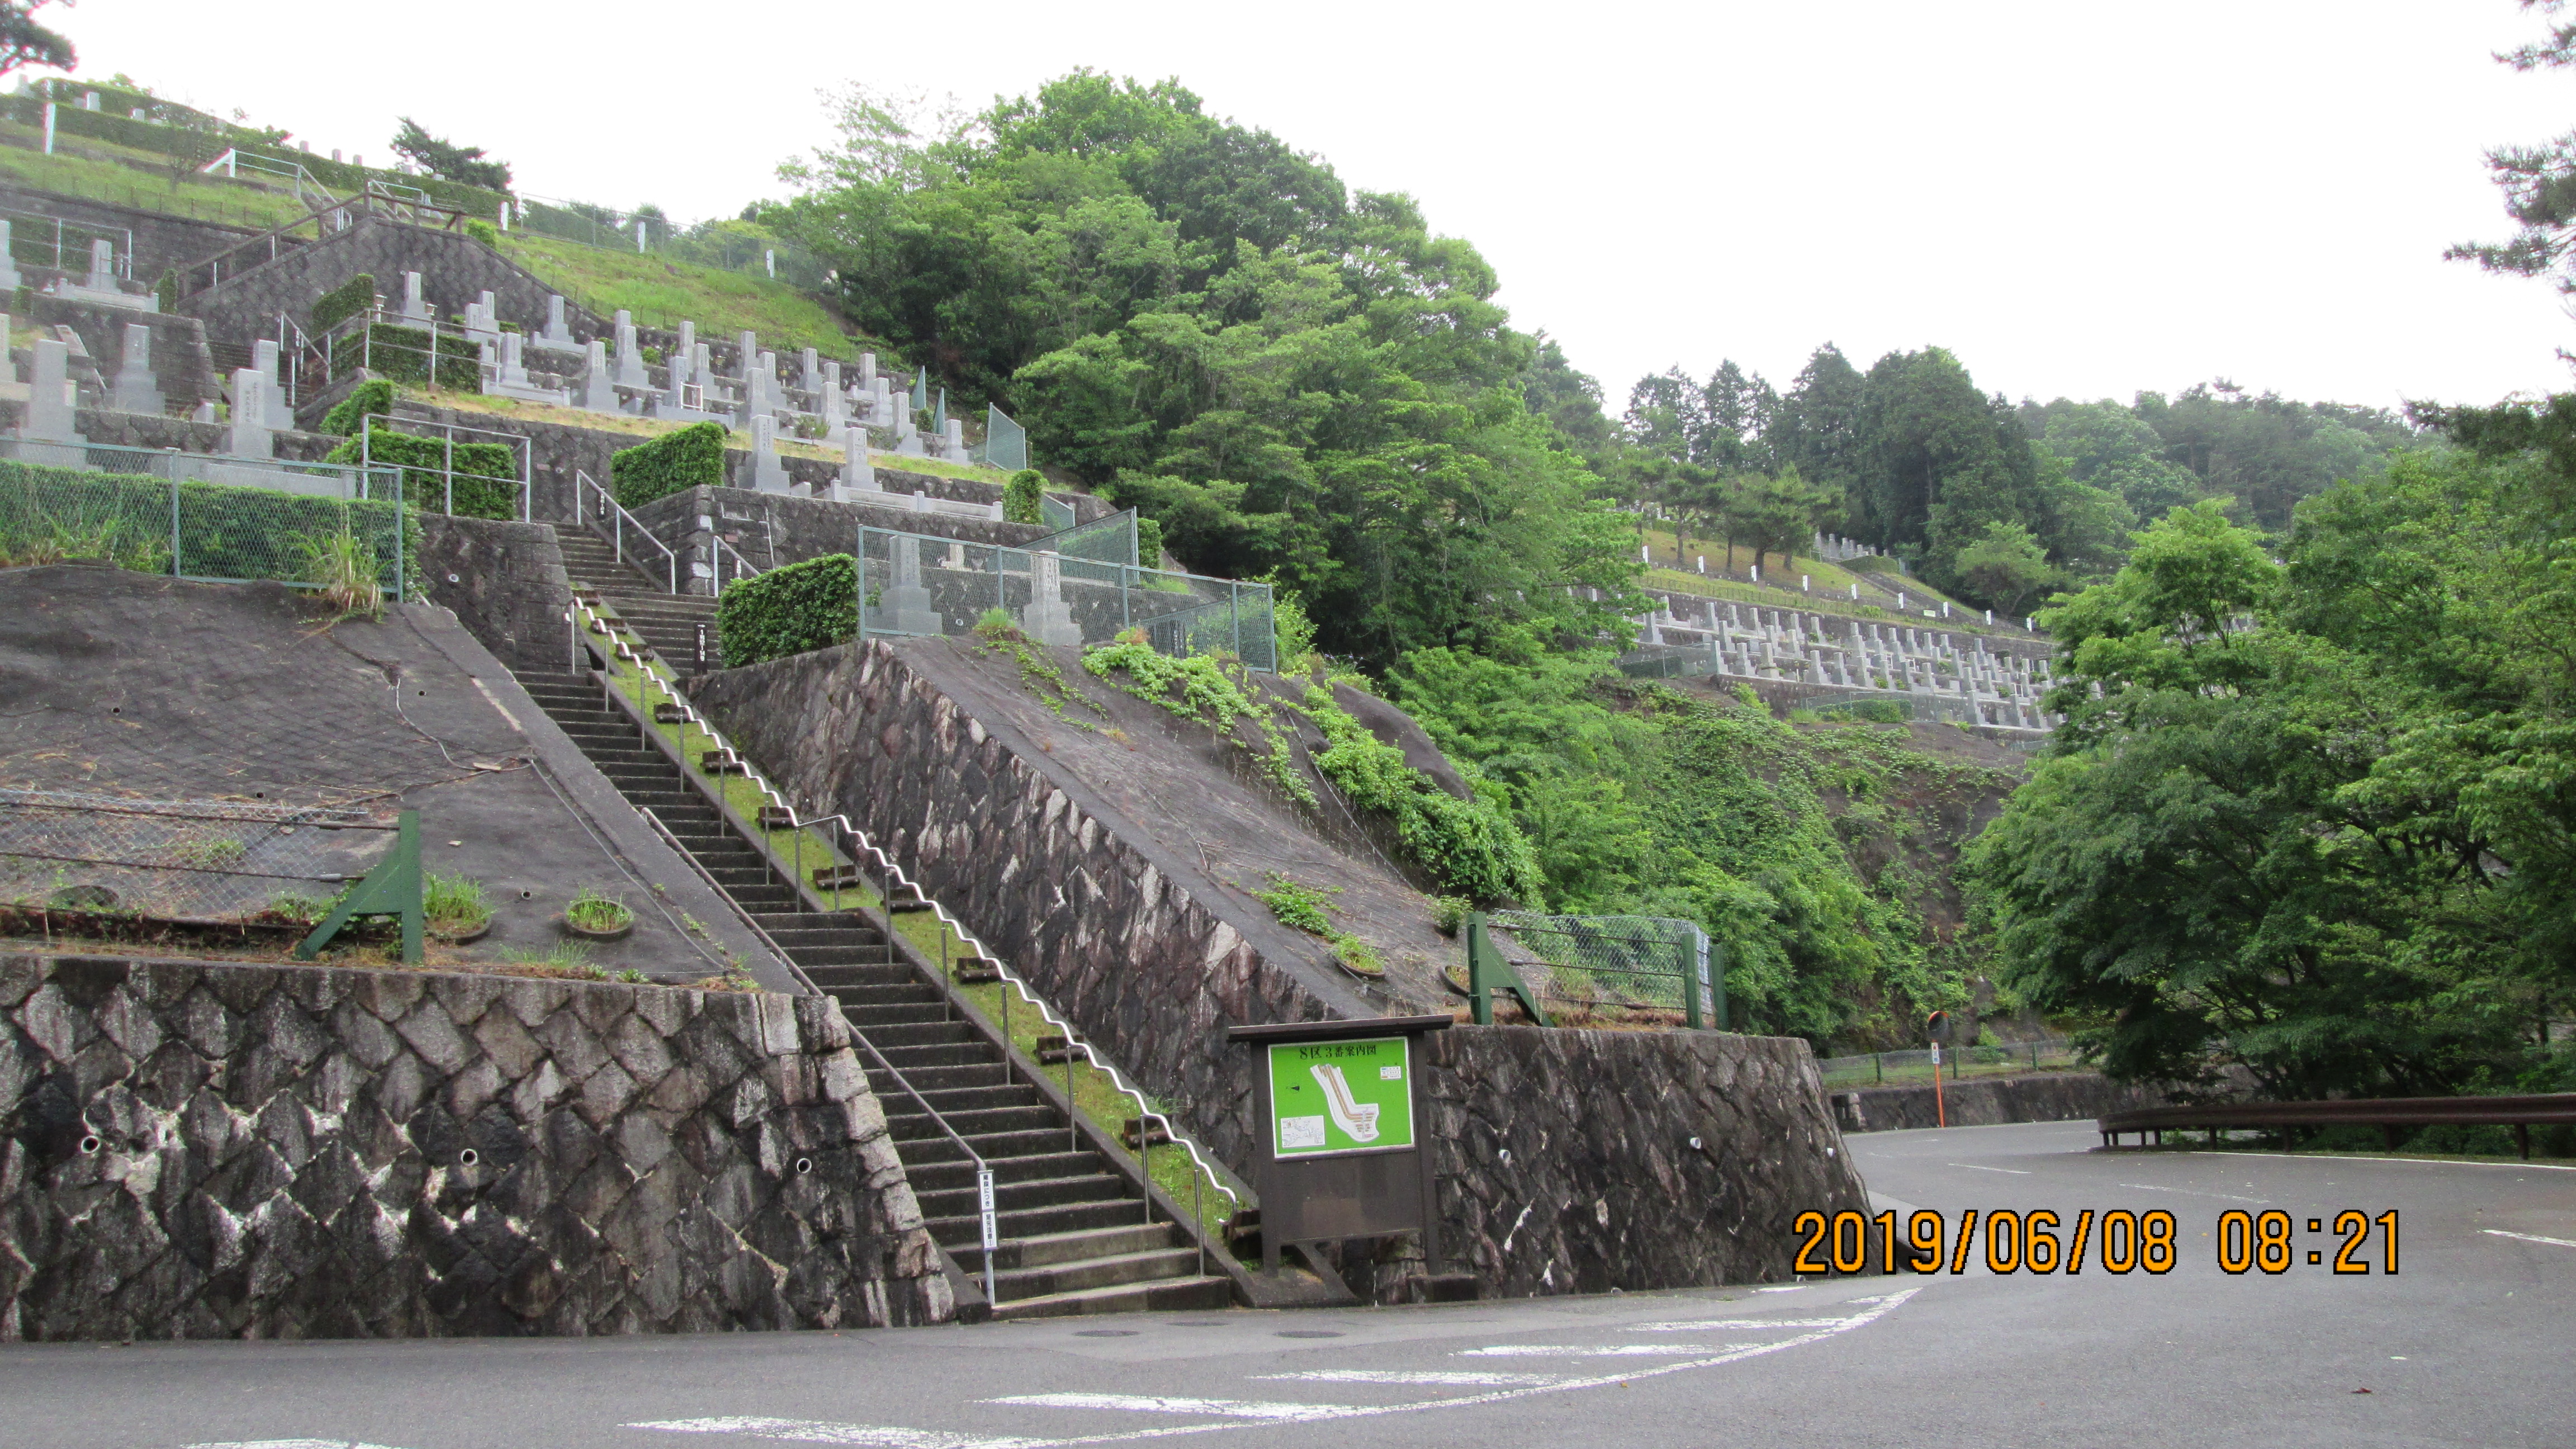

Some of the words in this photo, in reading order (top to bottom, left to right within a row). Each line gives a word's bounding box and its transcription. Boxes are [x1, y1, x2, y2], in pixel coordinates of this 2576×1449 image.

[1300, 1044, 1376, 1060] 8区3番案内図
